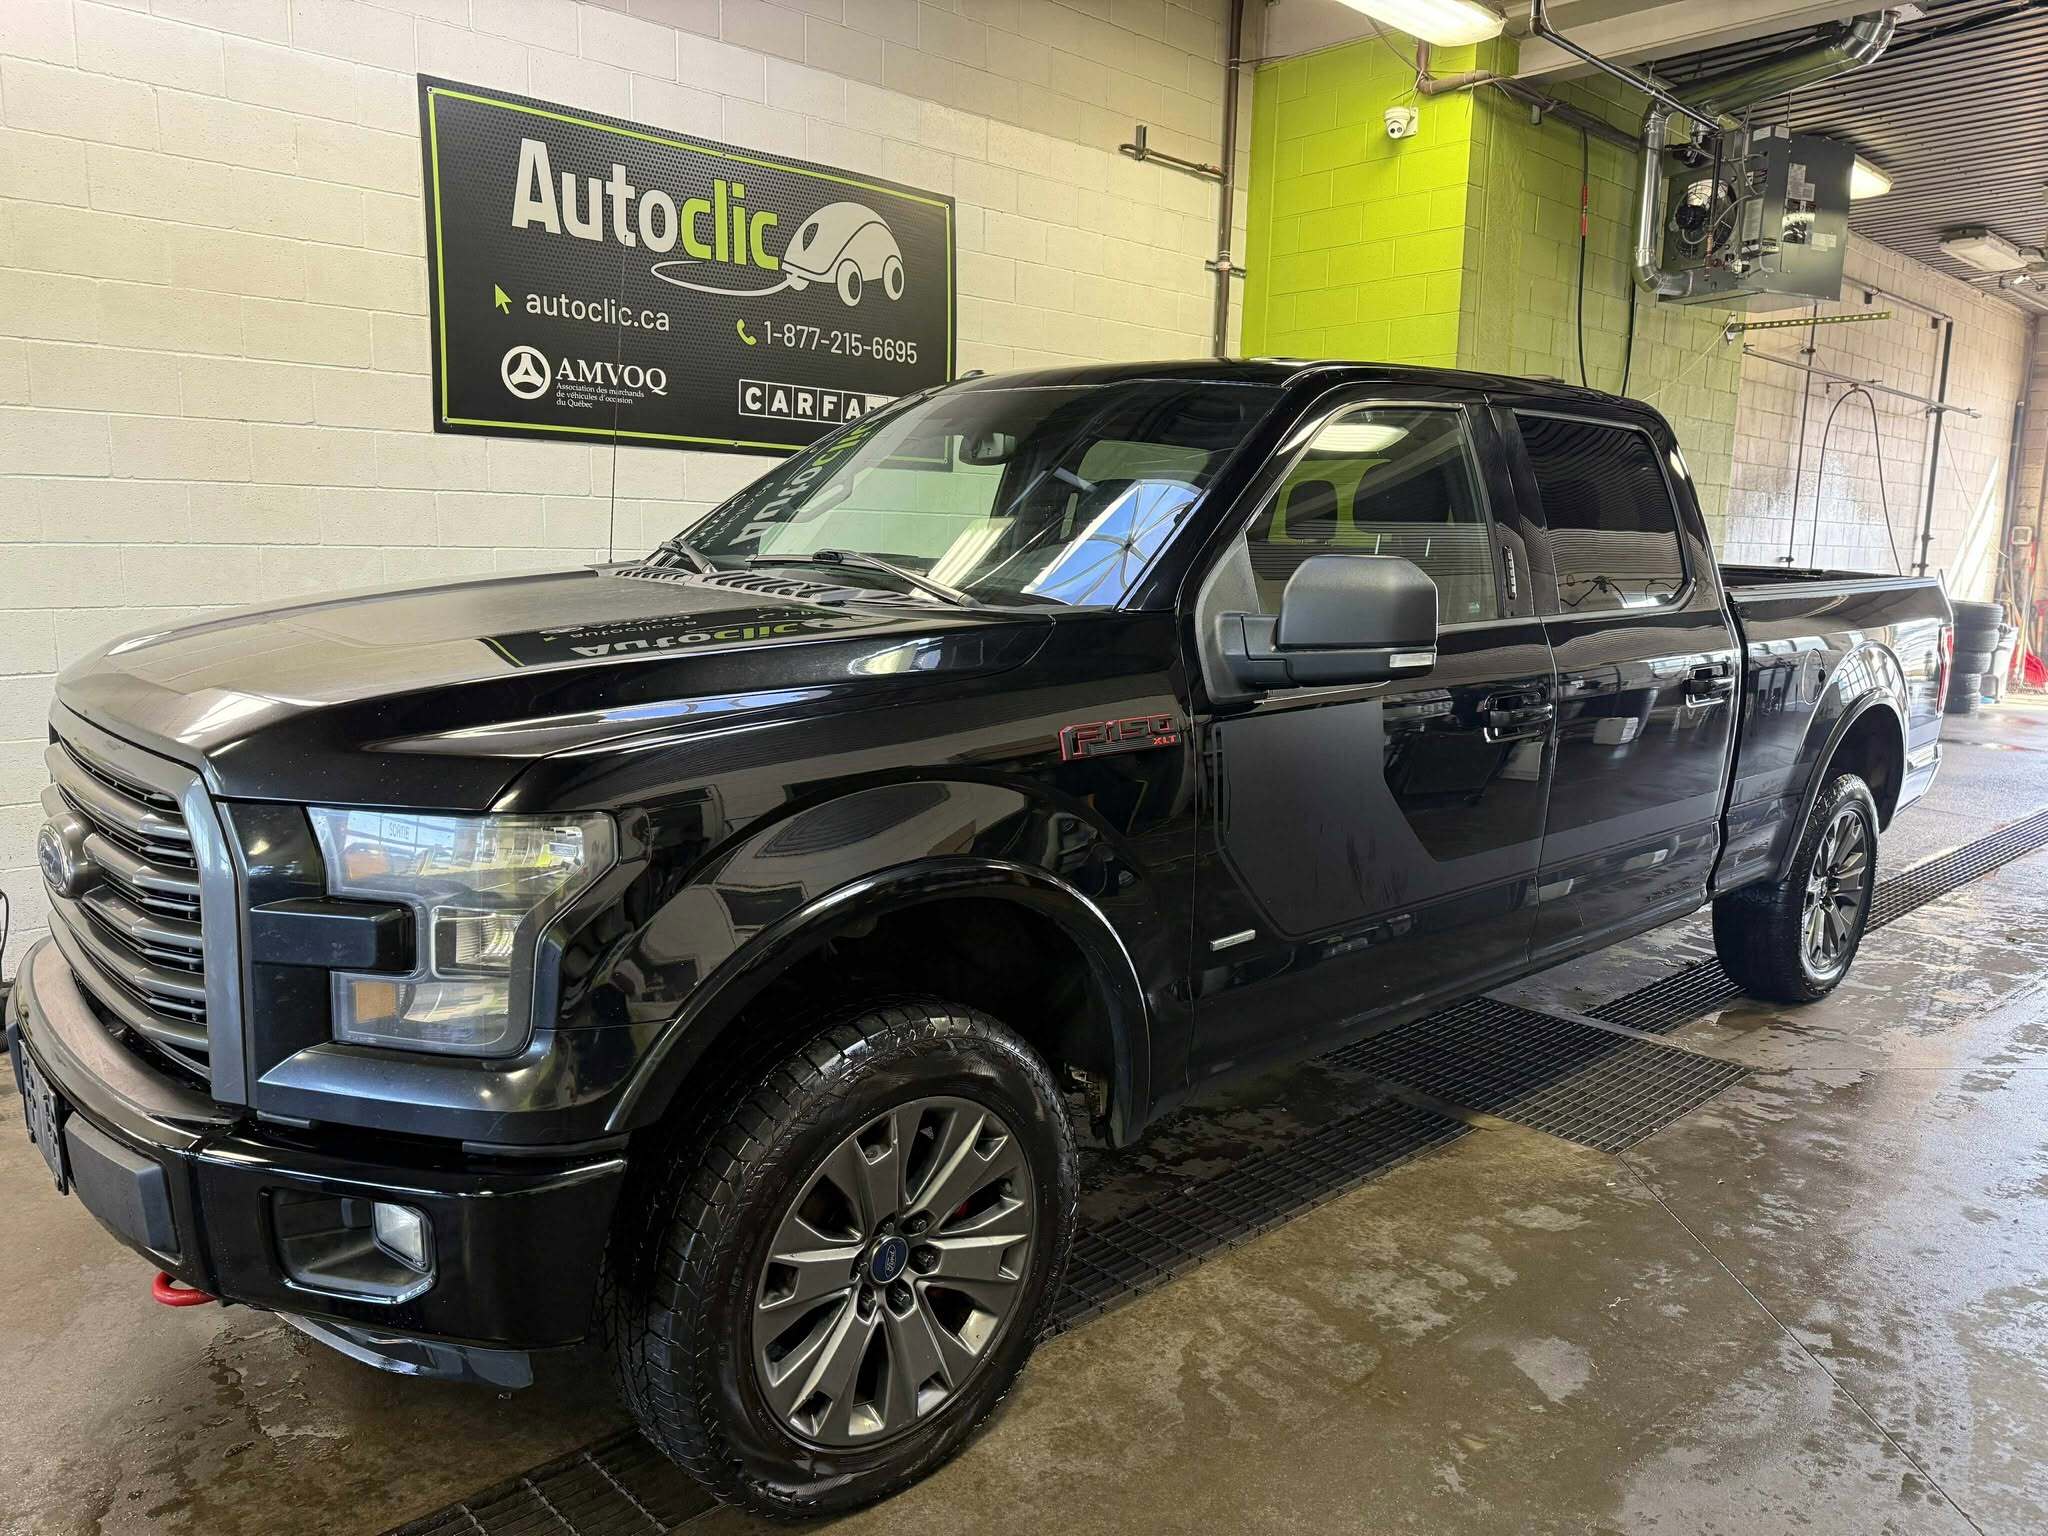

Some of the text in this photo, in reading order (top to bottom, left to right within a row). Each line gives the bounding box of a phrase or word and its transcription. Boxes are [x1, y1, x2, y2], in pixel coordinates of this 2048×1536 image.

[511, 137, 779, 271] Autoclic
[525, 292, 671, 332] autoclic.ca
[763, 320, 918, 364] 1-877-215-6695
[555, 357, 668, 396] AMVOQ
[556, 382, 595, 393] Association
[596, 386, 608, 394] des
[556, 398, 593, 409] du Québec
[566, 391, 598, 400] véhicules
[1153, 735, 1177, 745] XLT
